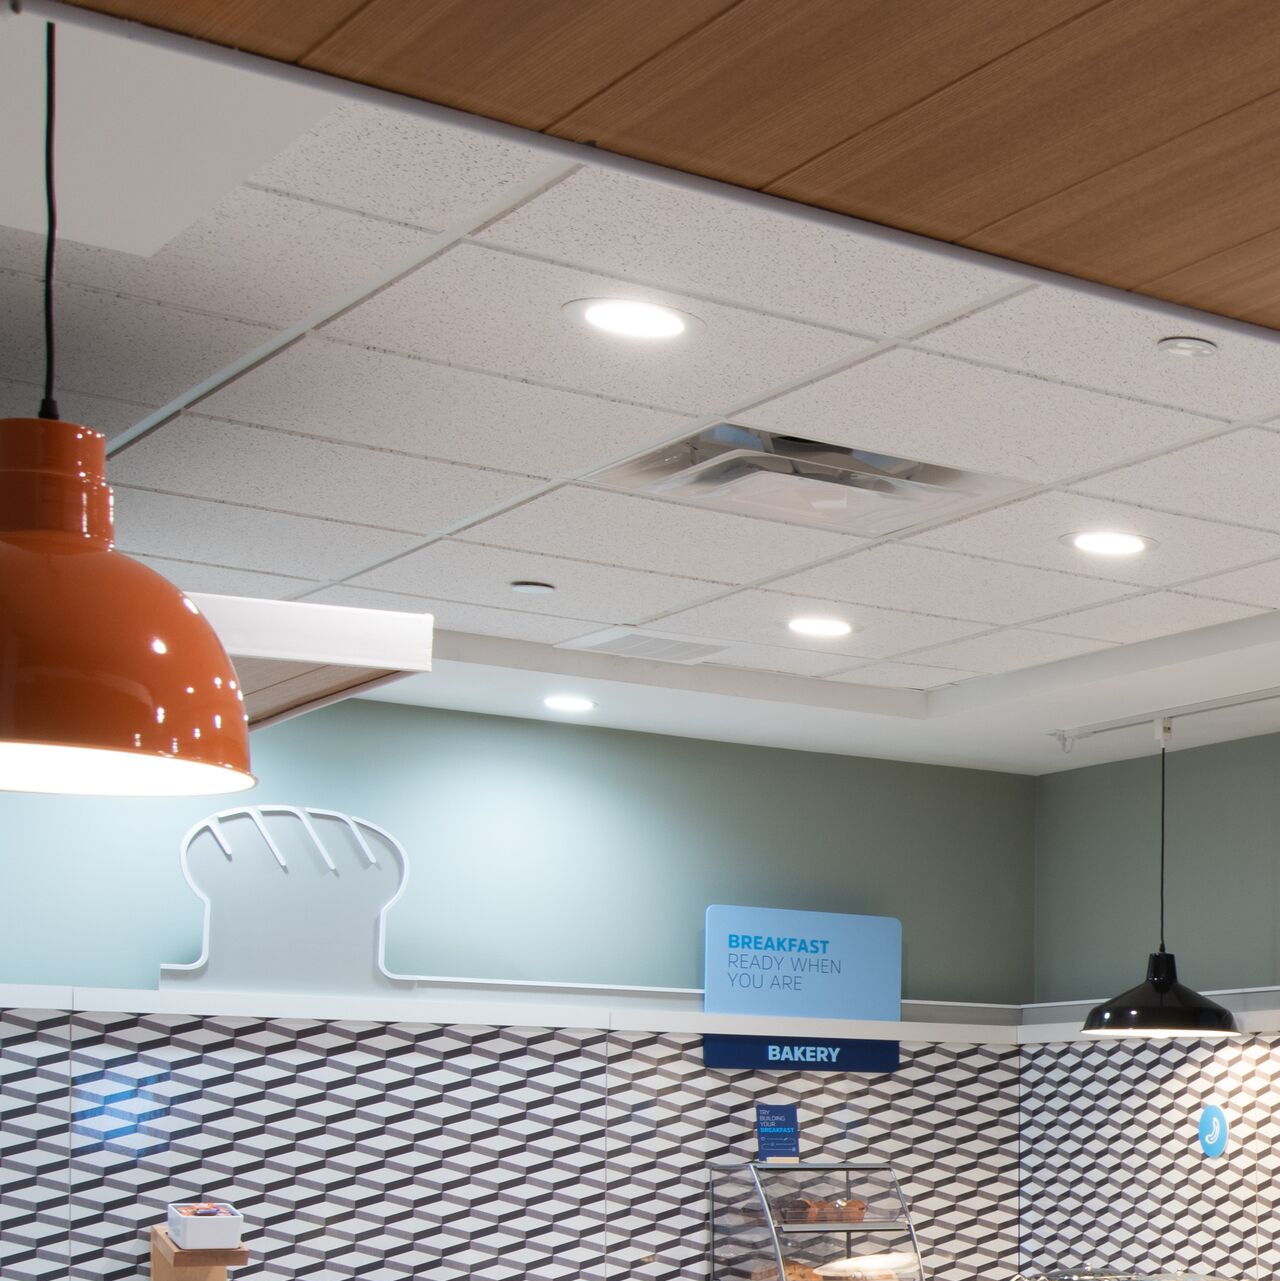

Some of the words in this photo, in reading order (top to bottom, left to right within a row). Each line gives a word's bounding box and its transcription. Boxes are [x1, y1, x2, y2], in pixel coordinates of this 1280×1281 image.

[728, 933, 830, 954] BREAKFAST
[728, 953, 785, 971] READY
[790, 957, 842, 975] WHEN
[728, 972, 764, 989] YOU
[769, 975, 803, 991] ARE
[768, 1045, 841, 1063] BAKERY
